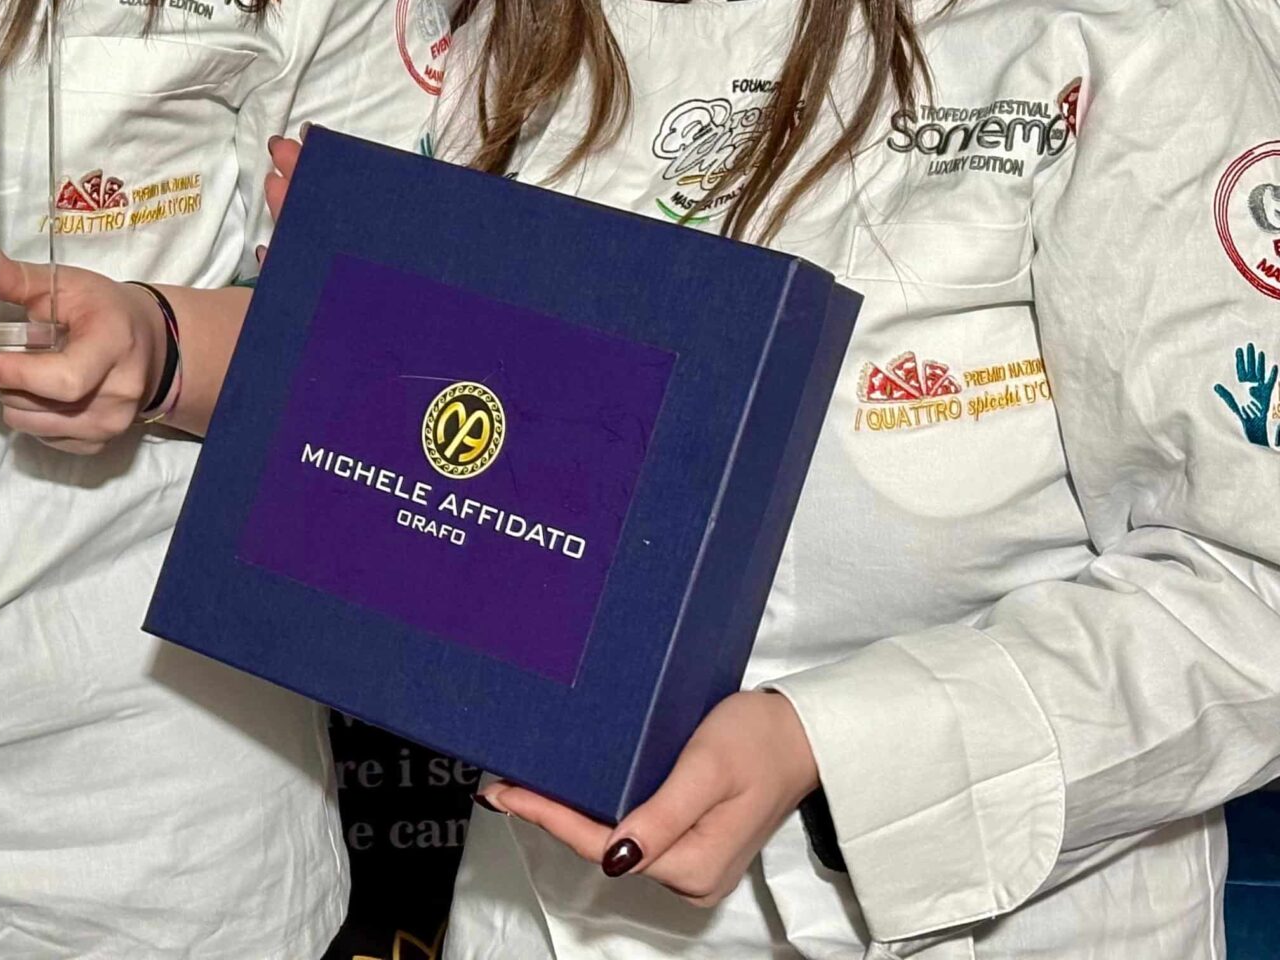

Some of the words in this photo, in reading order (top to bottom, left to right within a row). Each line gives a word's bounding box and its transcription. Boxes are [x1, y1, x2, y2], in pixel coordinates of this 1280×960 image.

[921, 104, 969, 122] TROFEO
[991, 99, 1052, 119] FESTIVAL
[928, 156, 969, 176] LUXURY
[969, 155, 1024, 177] EDITION
[53, 211, 126, 234] QUATTRO
[963, 365, 1006, 388] PREMIO
[1008, 357, 1047, 380] NAZION
[866, 396, 962, 431] QUATTRO
[967, 384, 1021, 422] spicchi
[301, 442, 433, 506] MICHELE
[438, 493, 586, 560] AFFIDATO
[396, 508, 466, 546] ORAFO
[398, 748, 413, 787] i
